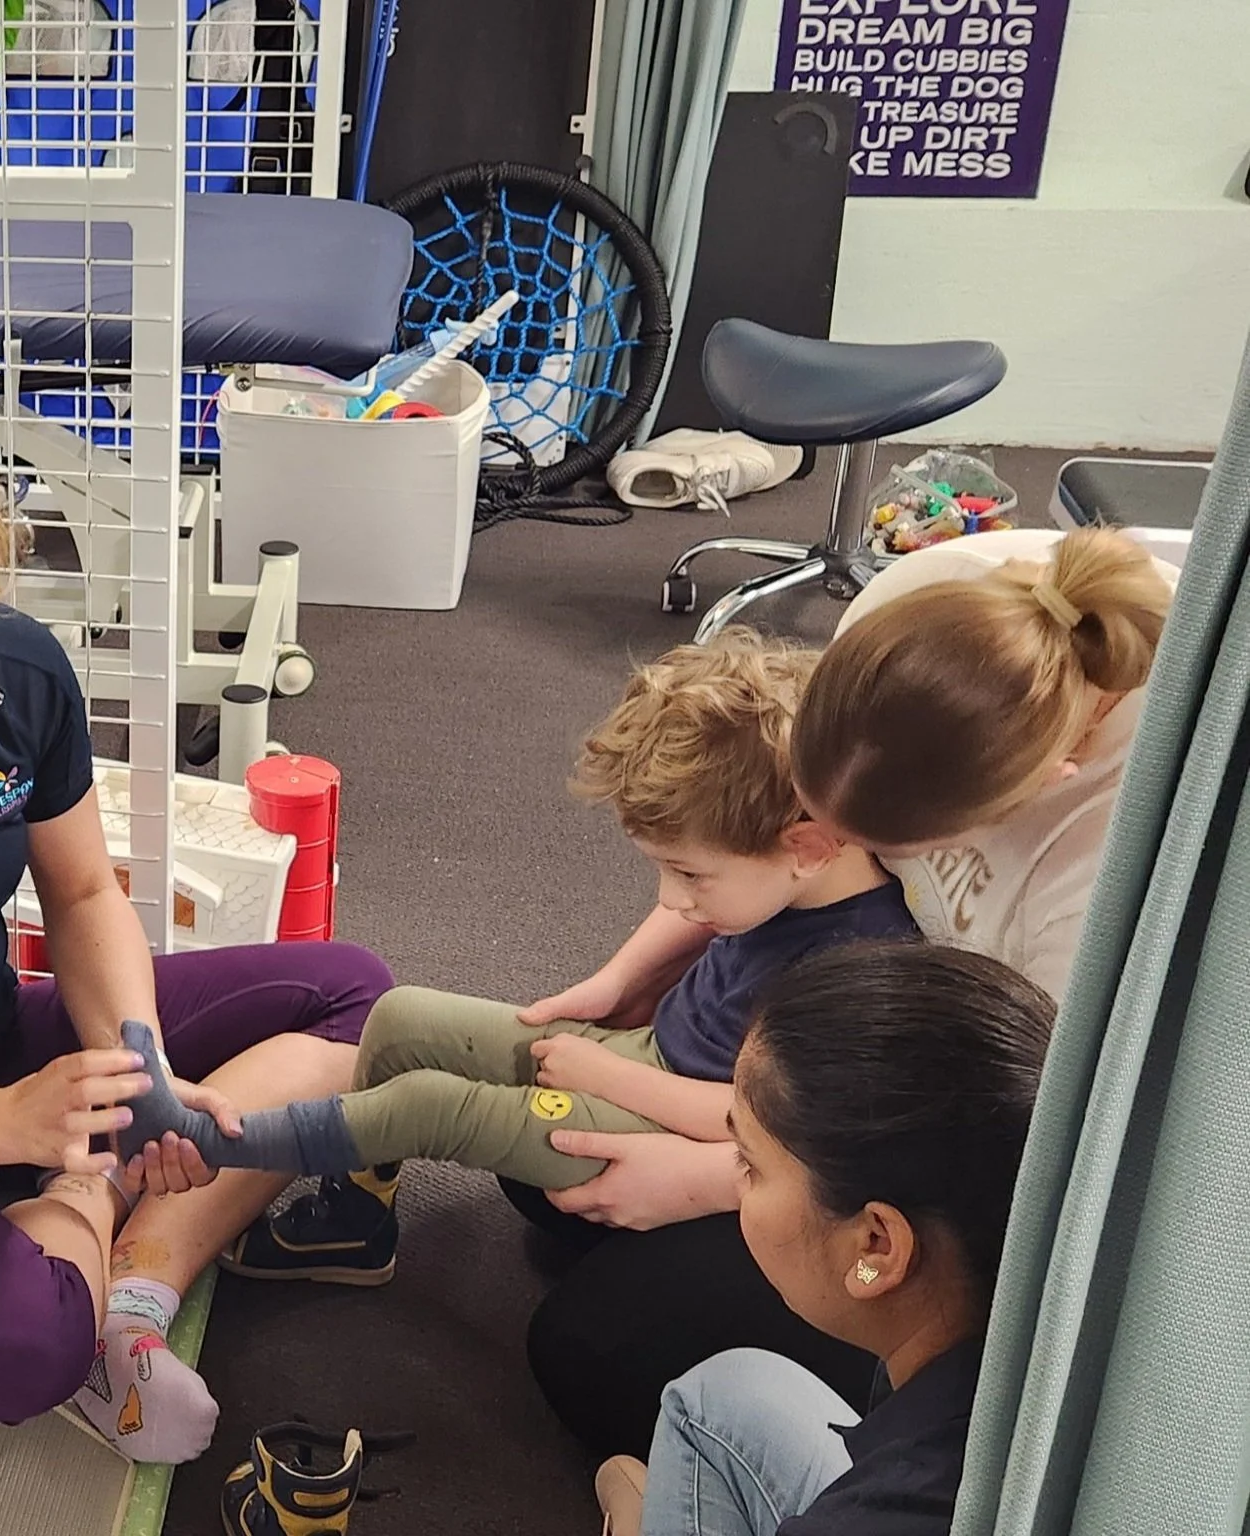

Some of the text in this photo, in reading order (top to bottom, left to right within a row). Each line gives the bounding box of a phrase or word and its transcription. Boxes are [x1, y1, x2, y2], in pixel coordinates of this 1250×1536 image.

[797, 18, 1034, 46] DREAM BIG
[794, 49, 1029, 74] BUILD CUBBIES
[791, 75, 1024, 99] HUG THE DOG
[862, 101, 1020, 124] TREASURE
[860, 125, 1017, 151] UP DIRT
[849, 151, 1012, 178] KE MESS
